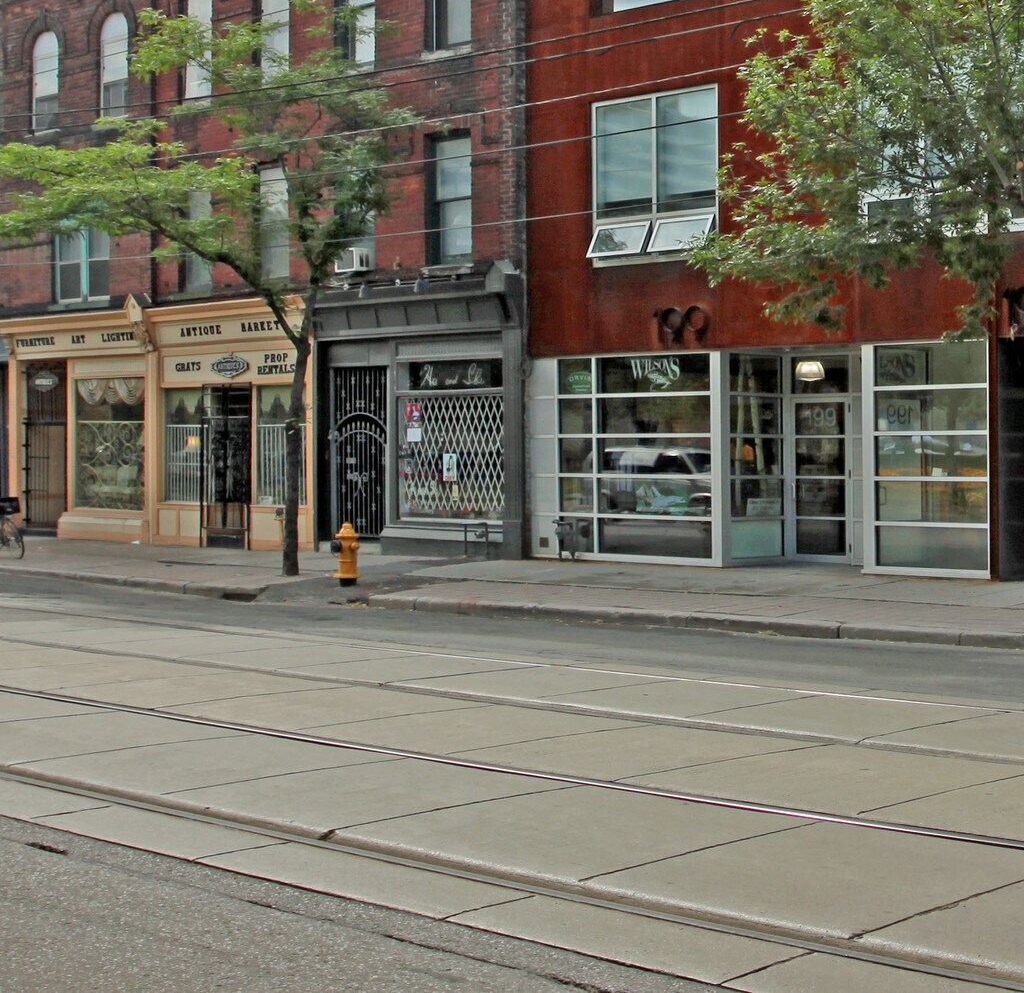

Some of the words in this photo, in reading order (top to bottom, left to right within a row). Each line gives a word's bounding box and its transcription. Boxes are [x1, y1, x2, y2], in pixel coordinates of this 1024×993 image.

[180, 325, 222, 337] ANTIQUE
[241, 320, 280, 333] MARKET
[16, 337, 55, 347] FURNITURE
[71, 335, 85, 344] ART
[101, 331, 134, 343] LIGHTIN
[264, 353, 288, 363] PROP
[257, 364, 295, 376] RENTALS
[803, 408, 837, 427] 199
